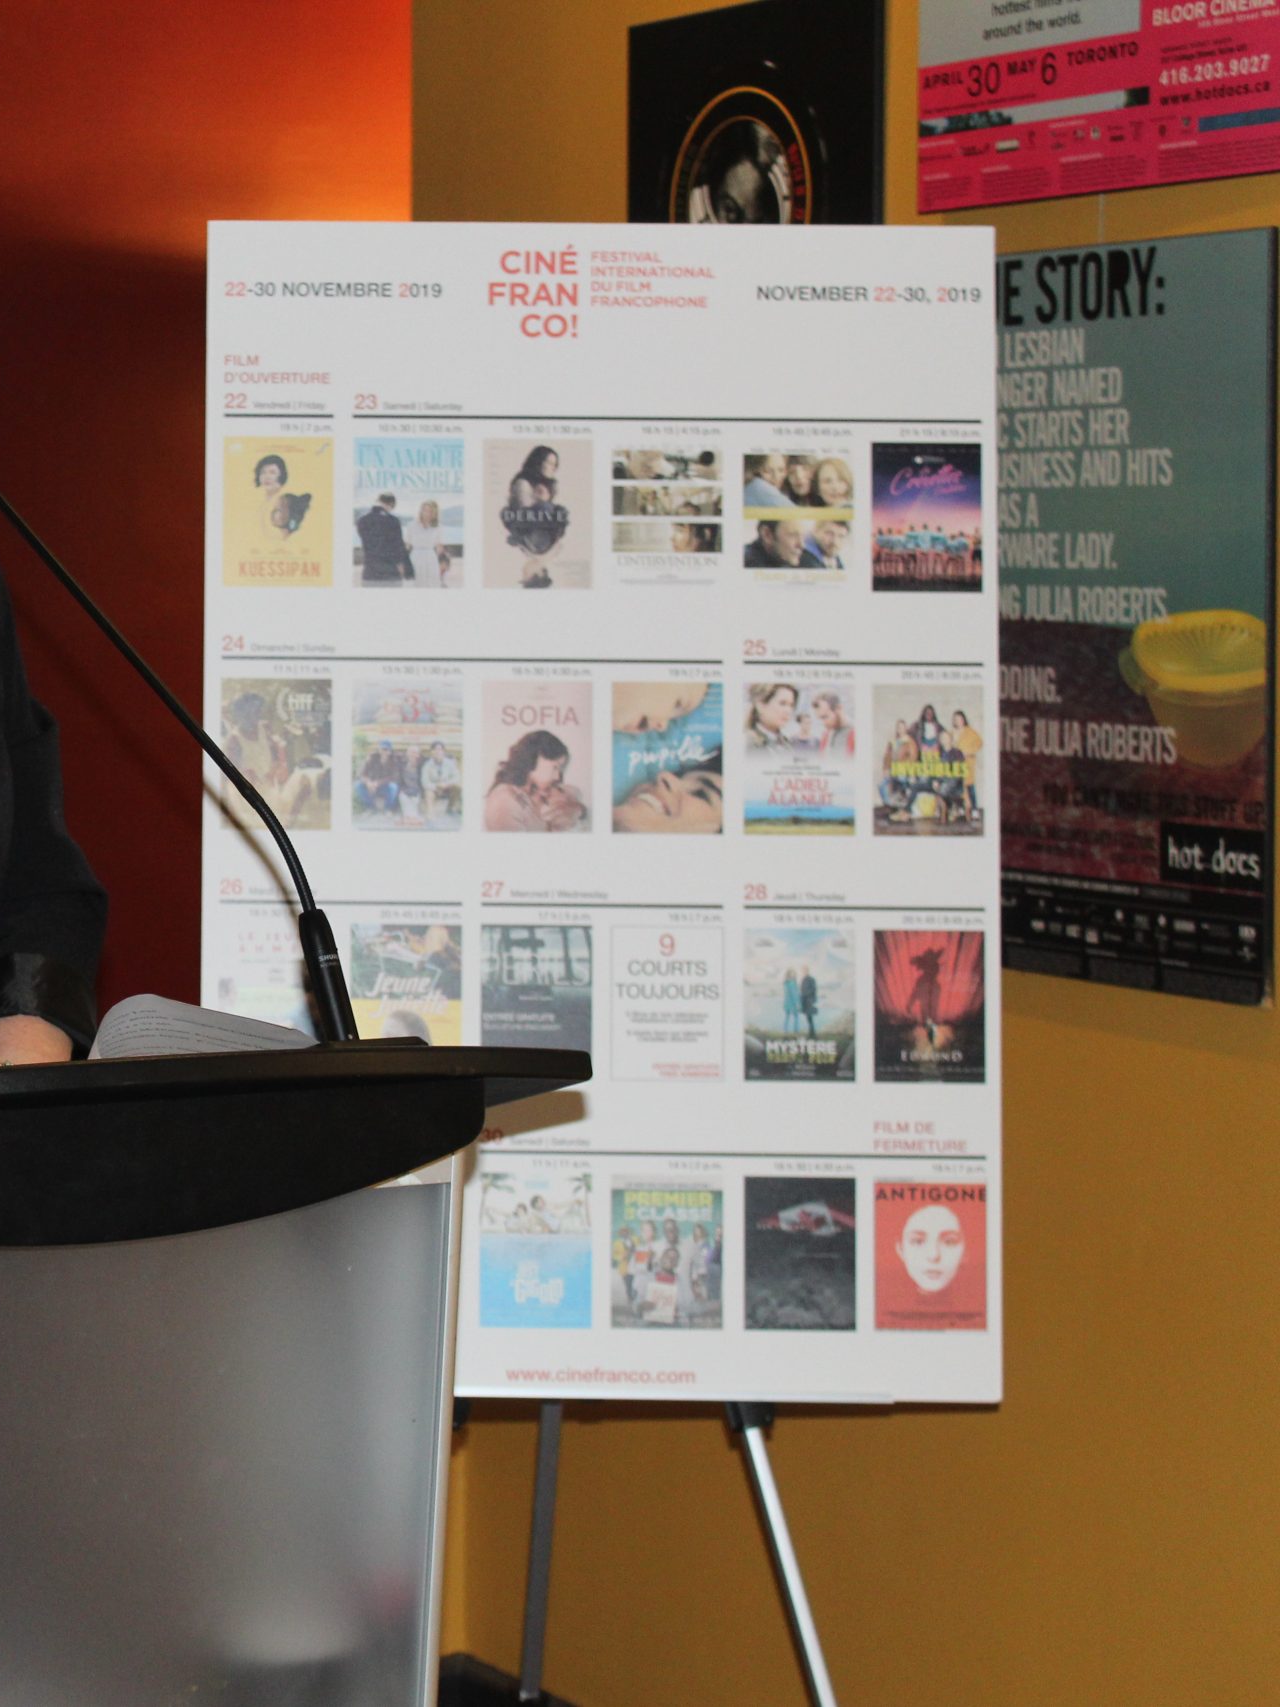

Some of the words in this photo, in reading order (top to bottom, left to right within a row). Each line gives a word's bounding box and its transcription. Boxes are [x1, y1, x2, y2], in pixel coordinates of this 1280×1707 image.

[1152, 2, 1206, 26] BLOOR
[982, 20, 1021, 41] around
[1025, 17, 1043, 32] the
[923, 72, 964, 89] APRIL
[967, 63, 1001, 97] 30
[1007, 58, 1036, 76] MAY
[1040, 52, 1058, 85] 6
[1067, 41, 1139, 66] TORONTO
[1158, 54, 1271, 86] 416.203.9027
[500, 244, 578, 275] CINÉ
[591, 252, 661, 263] FESTIVAL
[591, 266, 715, 280] INTERNATIONAL
[225, 282, 276, 298] 22-30
[282, 282, 392, 298] NOVEMBRE
[399, 283, 442, 299] 2019
[488, 282, 578, 307] FRAN
[591, 281, 612, 293] DU
[616, 281, 651, 293] FILM
[757, 285, 868, 302] NOVEMBER
[873, 286, 931, 305] 22-30,
[937, 287, 981, 302] 2019
[996, 260, 1024, 326] E
[1035, 246, 1165, 325] STORY:
[591, 296, 707, 308] FRANCOPHONE
[520, 313, 578, 338] CO!
[1004, 327, 1085, 368] LESBIAN
[224, 355, 260, 367] FILM
[224, 372, 331, 385] D'OUVERTURE
[1053, 366, 1122, 406] NAMED
[224, 394, 247, 409] 22
[354, 394, 378, 410] 23
[1015, 409, 1086, 448] STARTS
[1089, 408, 1130, 445] HER
[358, 447, 384, 468] UN
[390, 447, 464, 468] AMOUR
[997, 450, 1076, 488] USINESS
[1080, 449, 1121, 487] AND
[1127, 447, 1174, 486] HITS
[1025, 492, 1040, 528] A
[1064, 531, 1118, 570] LADY.
[238, 561, 321, 577] KUESSIPAN
[1024, 584, 1074, 622] JULIA
[222, 635, 245, 651] 24
[744, 640, 767, 656] 25
[501, 705, 580, 726] SOFIA
[1033, 717, 1082, 758] JULIA
[1087, 720, 1177, 765] ROBERTS
[1168, 835, 1204, 870] hot
[1211, 837, 1261, 879] docs
[220, 879, 243, 895] 26
[481, 881, 504, 898] 27
[744, 884, 768, 900] 28
[659, 934, 675, 957] 9
[627, 960, 708, 977] COURTS
[616, 983, 720, 1000] TOUJOURS
[873, 1121, 910, 1135] FILM
[915, 1122, 935, 1135] DE
[873, 1139, 968, 1152] FERMETURE
[875, 1187, 986, 1202] ANTIGONE
[506, 1367, 696, 1385] www.cinefranco.com
